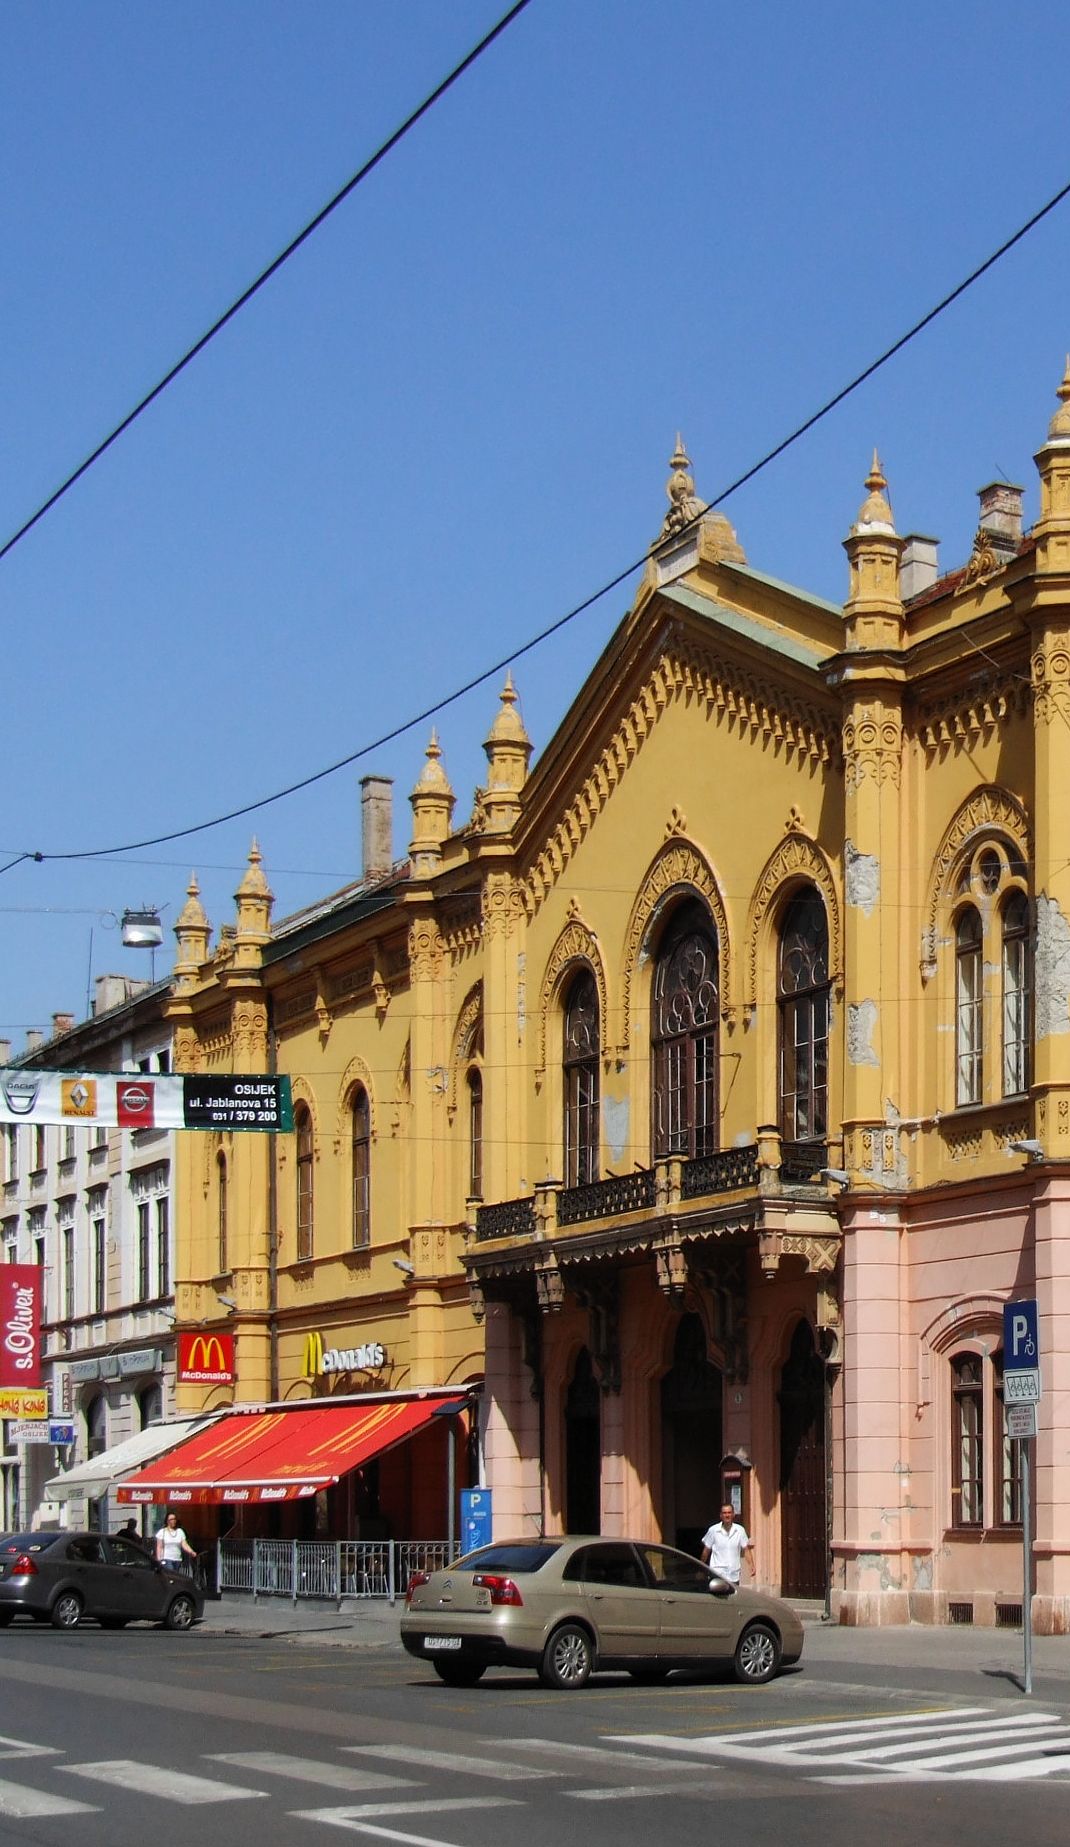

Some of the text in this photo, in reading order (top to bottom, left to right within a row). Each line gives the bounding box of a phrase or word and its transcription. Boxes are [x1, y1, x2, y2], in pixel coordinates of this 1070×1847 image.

[234, 1085, 276, 1095] OSIJEK
[189, 1098, 277, 1108] ul. Jablanova 15
[212, 1113, 227, 1121] 031
[236, 1111, 255, 1121] 379
[257, 1111, 277, 1121] 200
[1012, 1316, 1028, 1356] P
[182, 1371, 231, 1380] McDonald's
[470, 1493, 481, 1508] P
